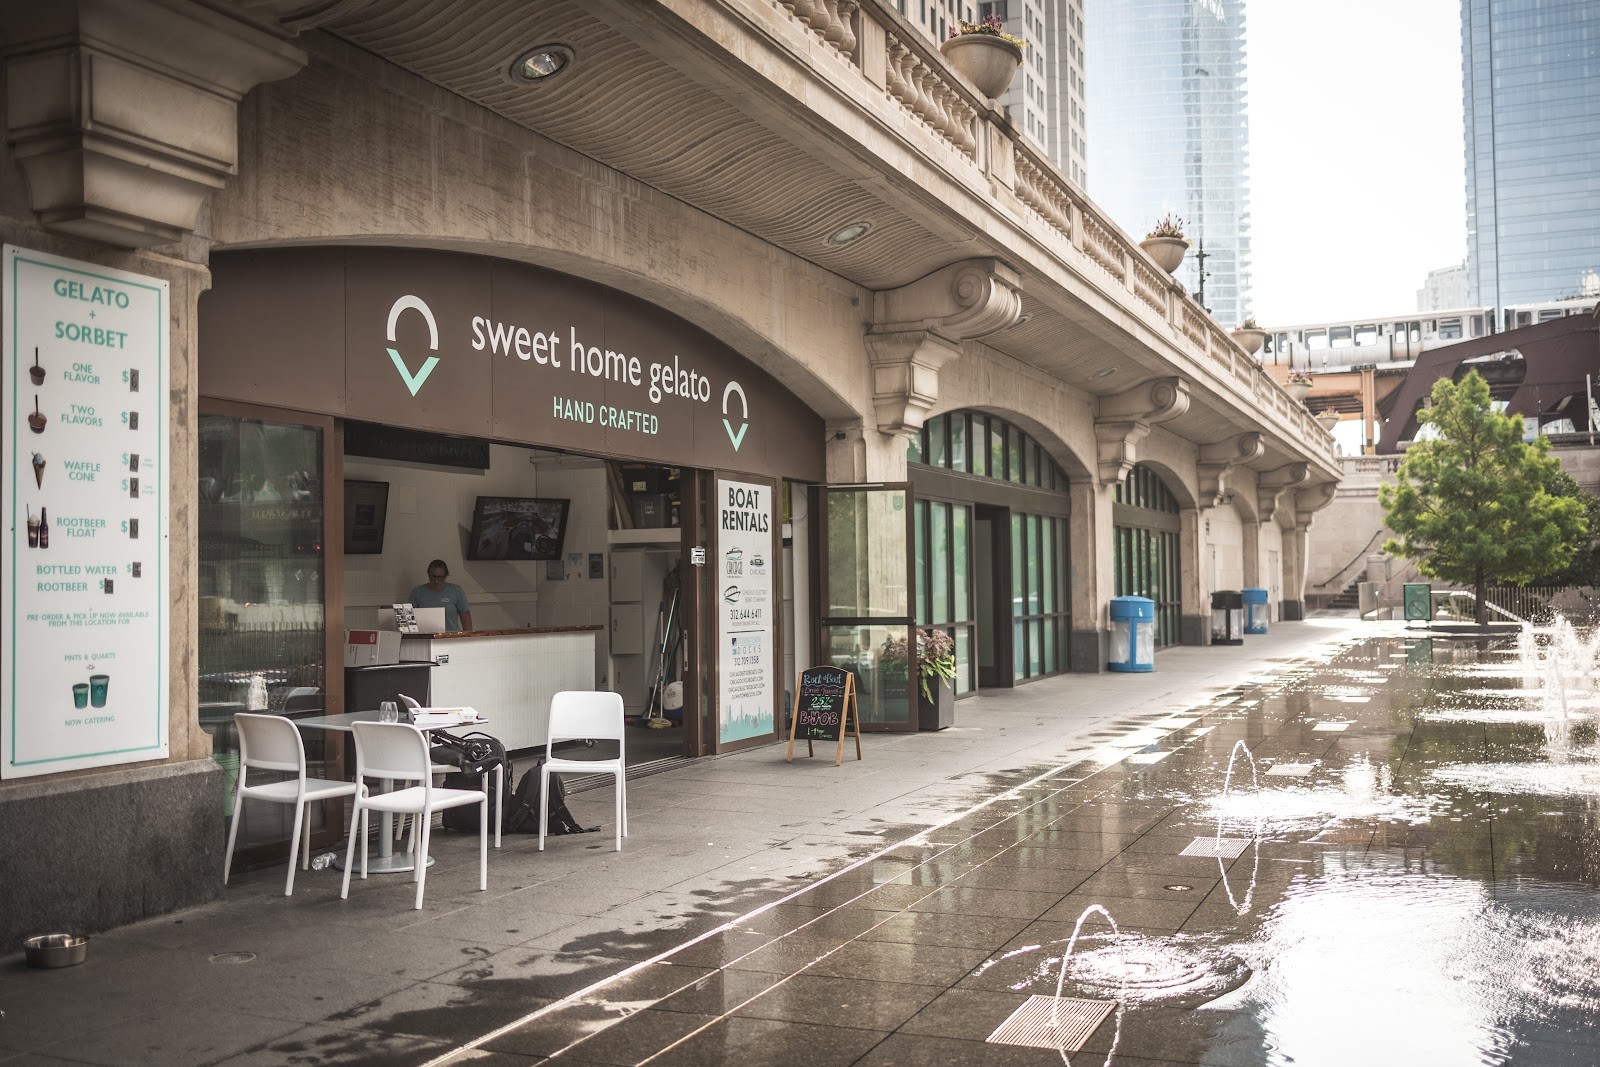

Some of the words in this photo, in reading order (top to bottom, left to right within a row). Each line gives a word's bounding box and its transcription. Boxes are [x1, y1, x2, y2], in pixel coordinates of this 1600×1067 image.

[53, 279, 129, 309] GELATO
[55, 321, 128, 349] SORBET
[472, 315, 561, 368] sweet
[571, 326, 642, 386] home
[649, 355, 710, 404] gelato
[72, 363, 92, 374] ONE
[64, 372, 100, 385] FLAVOR
[70, 405, 94, 416] TWO
[553, 397, 595, 424] HAND
[599, 405, 658, 435] CRAFTED
[61, 414, 103, 427] FLAVORS
[64, 460, 101, 473] WAFFLE
[69, 471, 95, 481] CONE
[729, 487, 759, 509] BOAT
[56, 518, 106, 528] ROOTBEER
[722, 510, 768, 532] RENTALS
[67, 528, 96, 538] FLOAT
[37, 565, 81, 575] BOTTLED
[85, 566, 117, 575] WATER
[38, 583, 88, 591] ROOTBEER
[91, 653, 116, 661] QUARTS
[84, 717, 114, 725] CATERING
